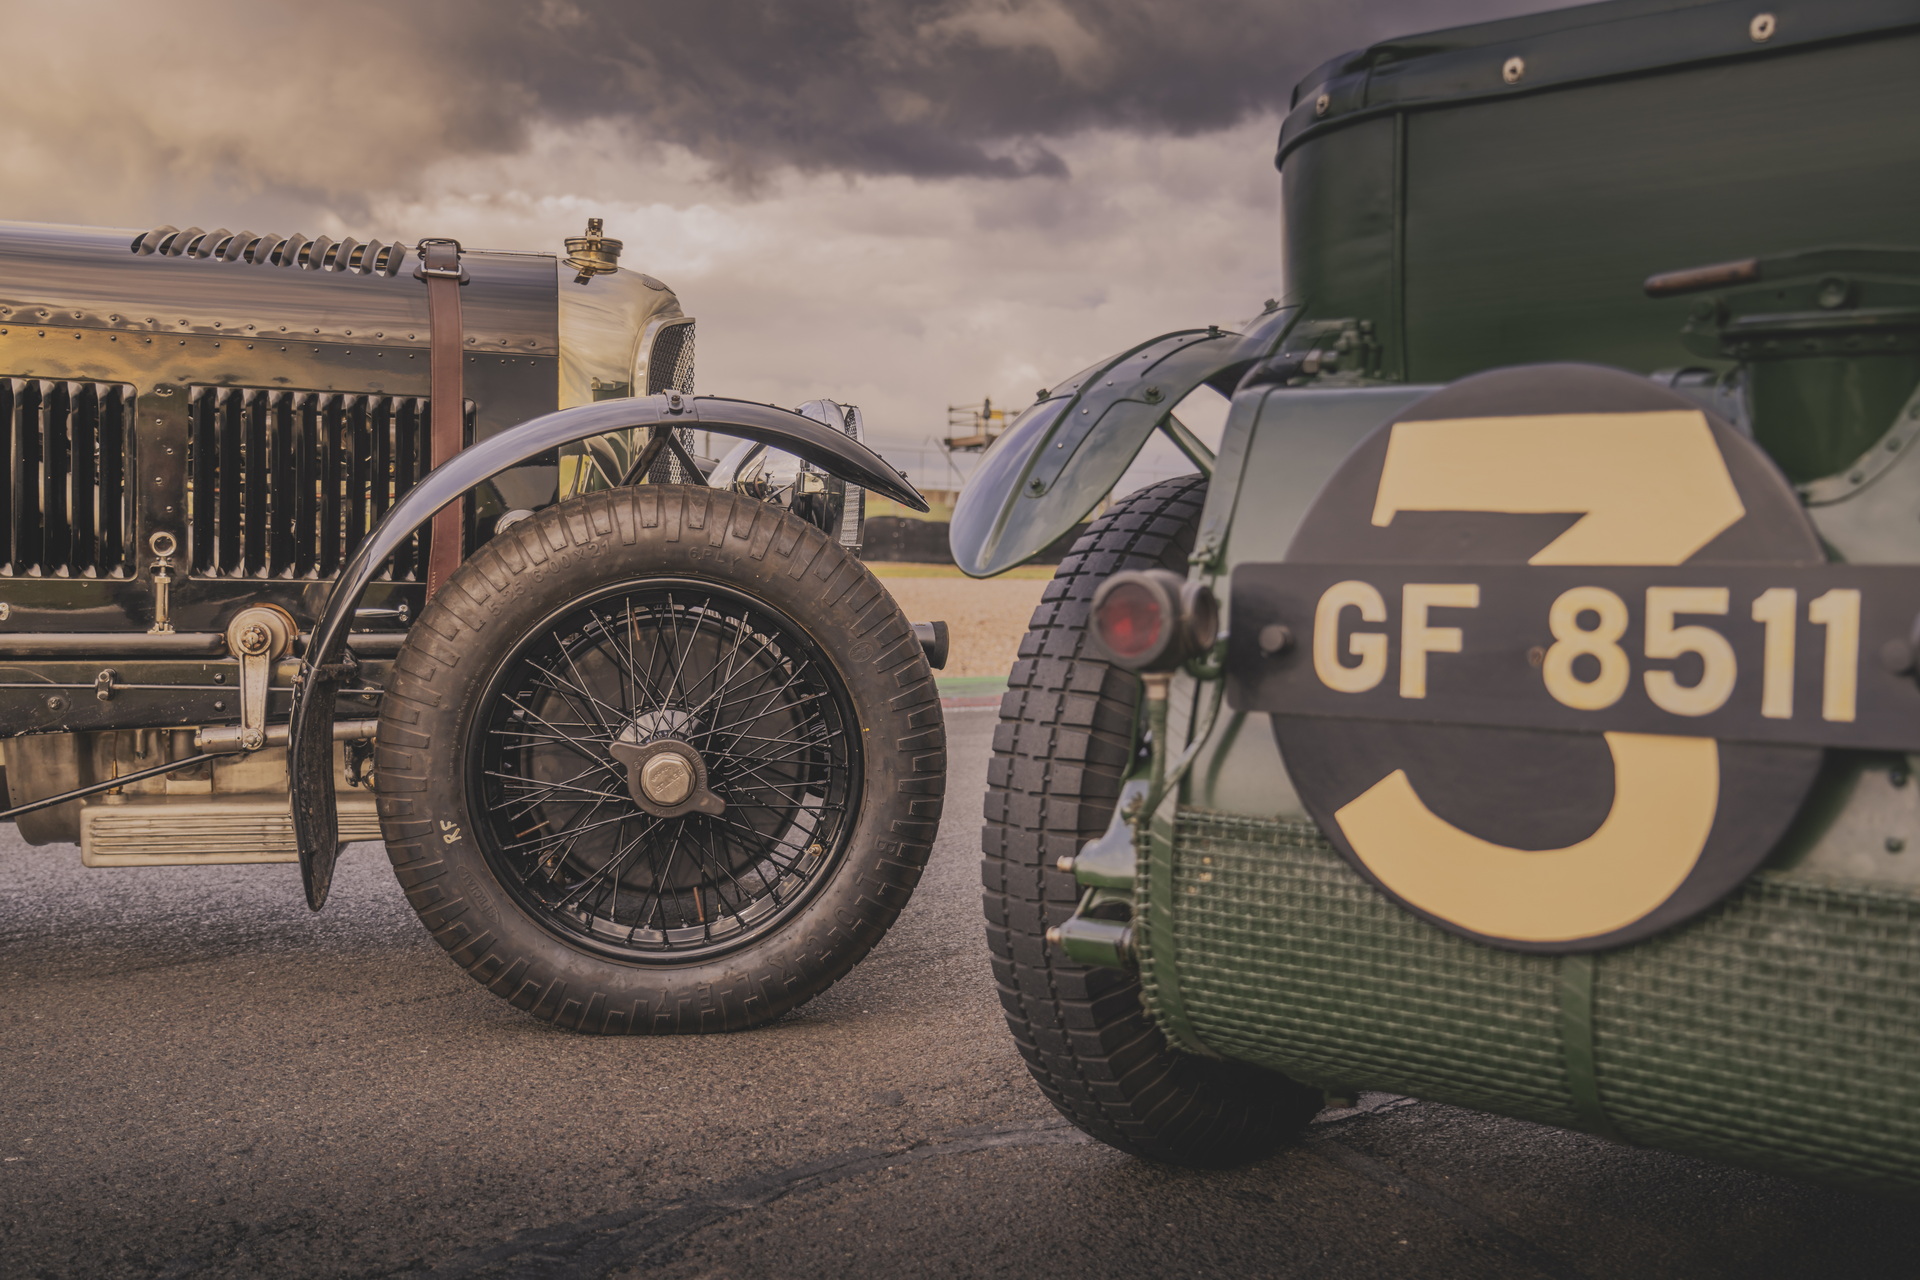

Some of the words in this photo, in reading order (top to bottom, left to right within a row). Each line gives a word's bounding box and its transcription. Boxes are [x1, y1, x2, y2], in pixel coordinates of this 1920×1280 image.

[1313, 580, 1480, 699] GF
[1542, 586, 1862, 722] 8511
[1335, 409, 1746, 943] 3
[440, 820, 462, 844] RF
